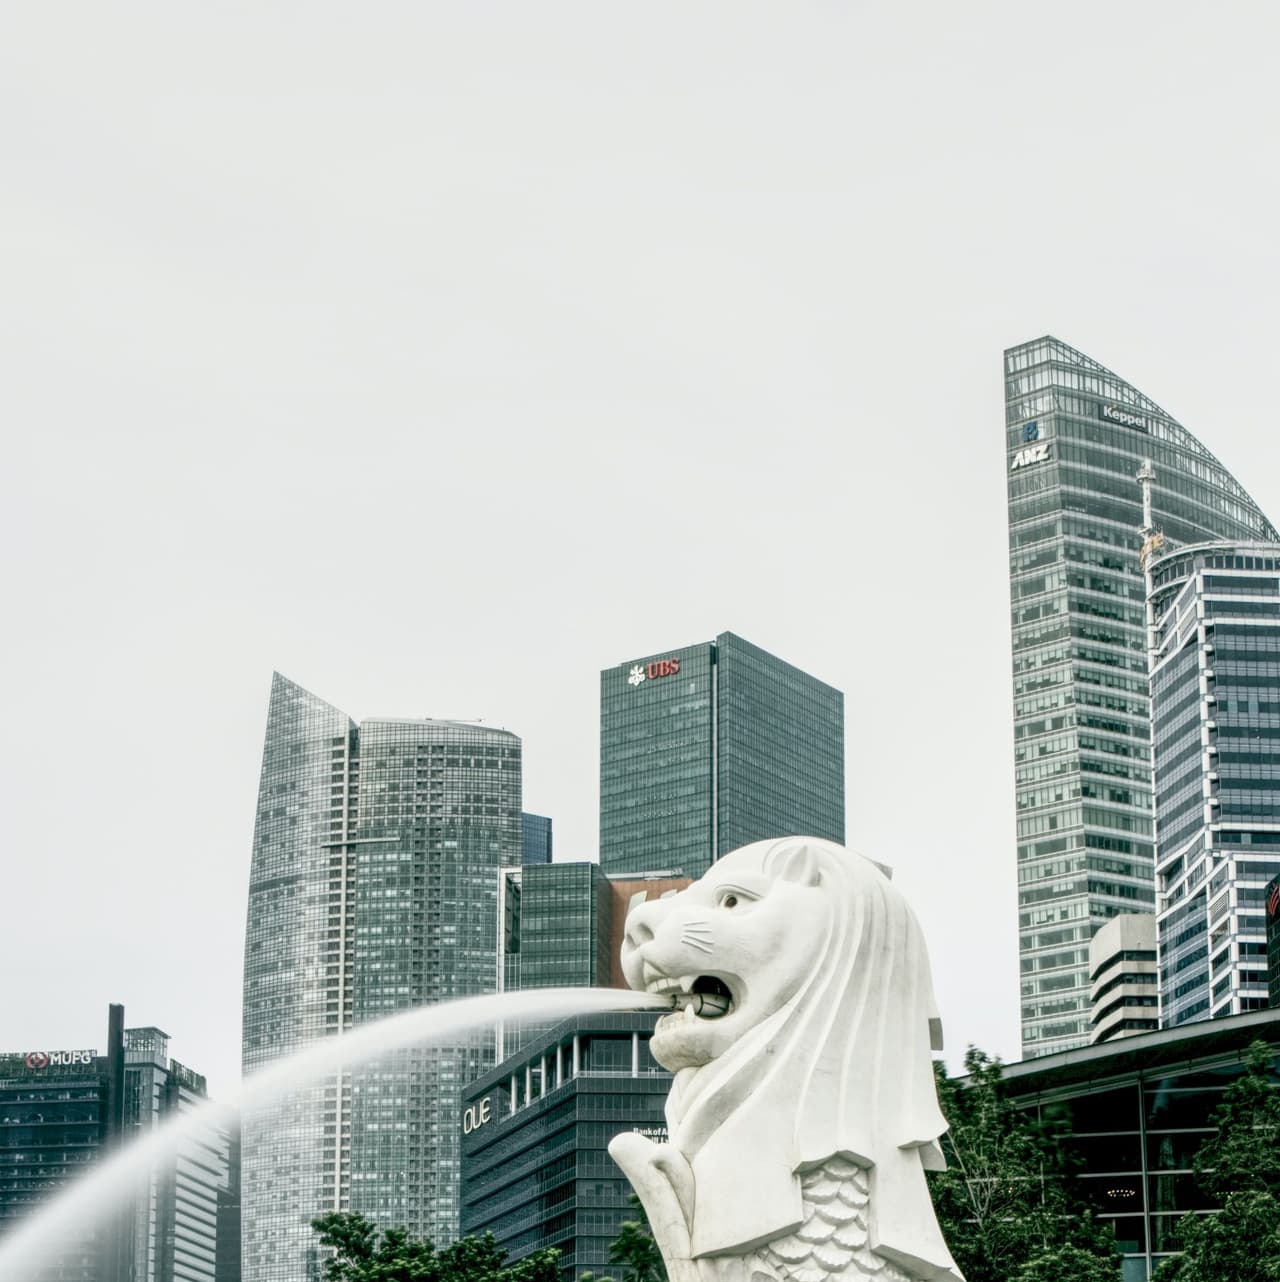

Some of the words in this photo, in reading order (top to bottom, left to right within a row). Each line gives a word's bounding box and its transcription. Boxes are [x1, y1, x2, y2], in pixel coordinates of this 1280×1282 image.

[1103, 404, 1147, 428] Keppel
[1011, 443, 1050, 470] ANZ
[647, 656, 680, 679] UBS
[49, 1051, 92, 1066] MUFG
[463, 1096, 491, 1135] OUE
